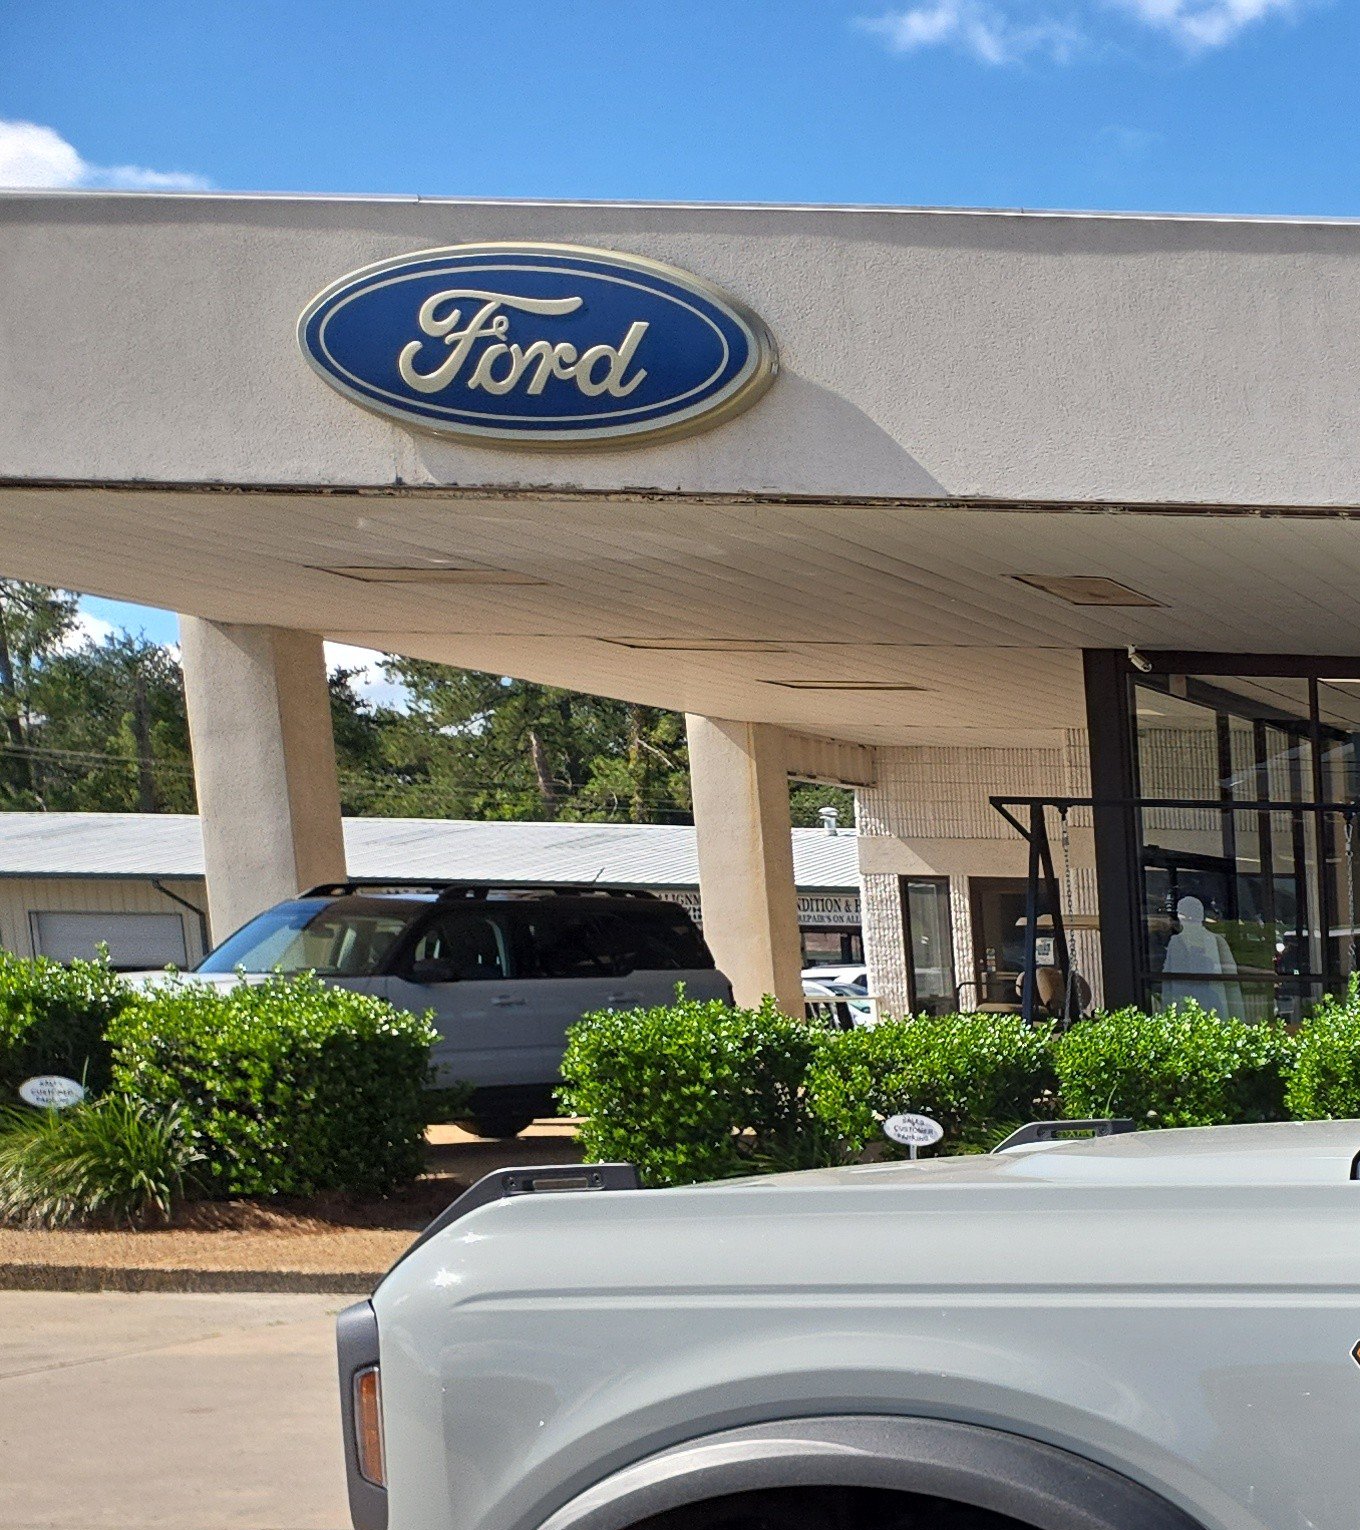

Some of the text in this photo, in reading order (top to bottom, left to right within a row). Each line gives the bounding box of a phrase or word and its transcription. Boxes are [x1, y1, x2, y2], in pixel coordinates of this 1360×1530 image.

[398, 289, 649, 398] Ford
[844, 898, 852, 913] &
[833, 914, 844, 923] ON
